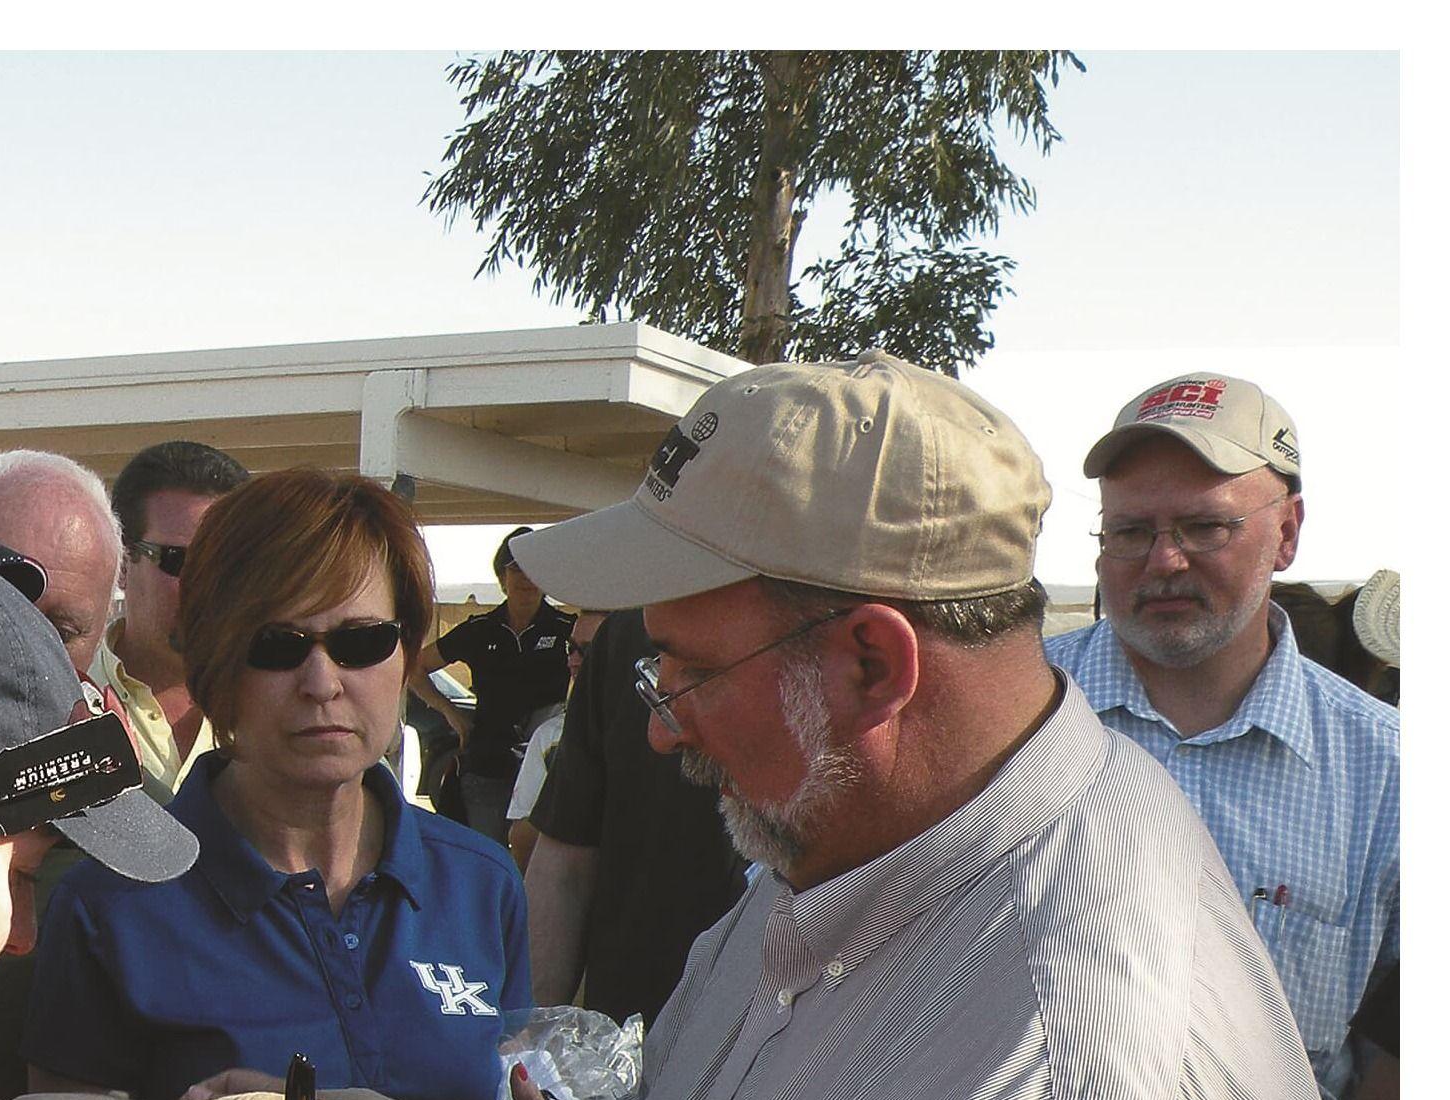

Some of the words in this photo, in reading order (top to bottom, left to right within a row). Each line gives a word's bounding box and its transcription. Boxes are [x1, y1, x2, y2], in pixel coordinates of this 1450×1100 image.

[1138, 384, 1223, 413] SCI
[15, 754, 92, 787] PREMIUM
[20, 750, 85, 775] AMMUNITION
[409, 960, 498, 1016] UK
